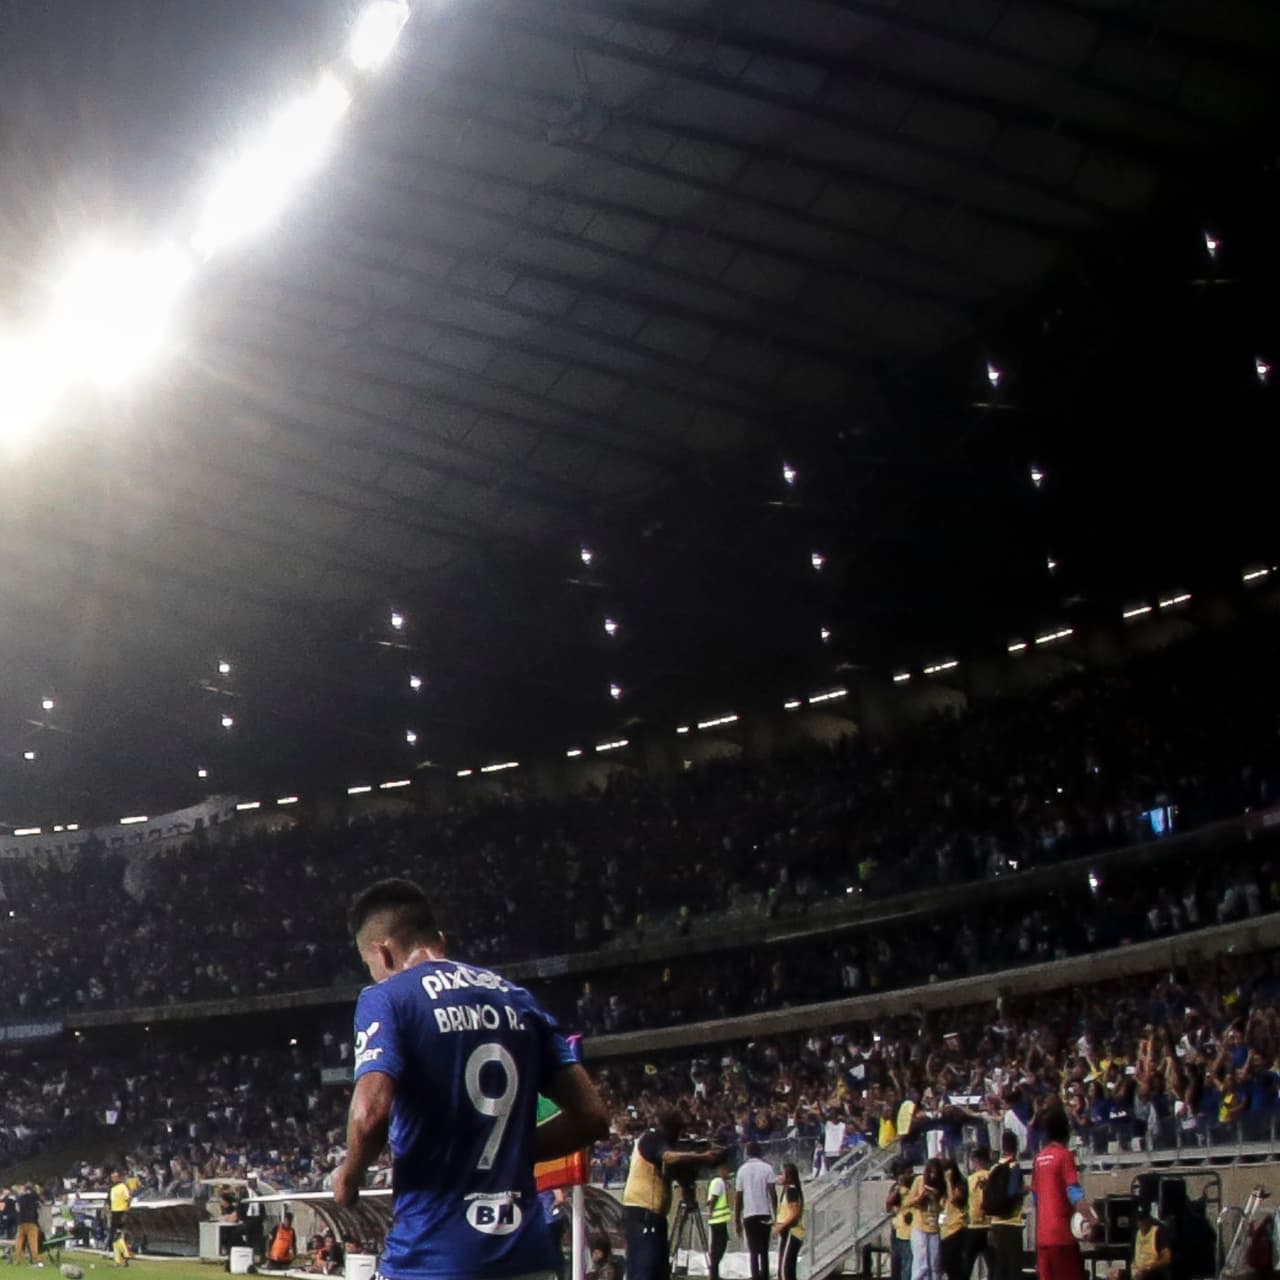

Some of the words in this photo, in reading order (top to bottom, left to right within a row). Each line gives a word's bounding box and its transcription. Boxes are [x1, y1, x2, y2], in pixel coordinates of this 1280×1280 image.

[434, 1005, 500, 1033] BRUNO
[465, 1042, 519, 1170] 9
[476, 1203, 514, 1225] BH
